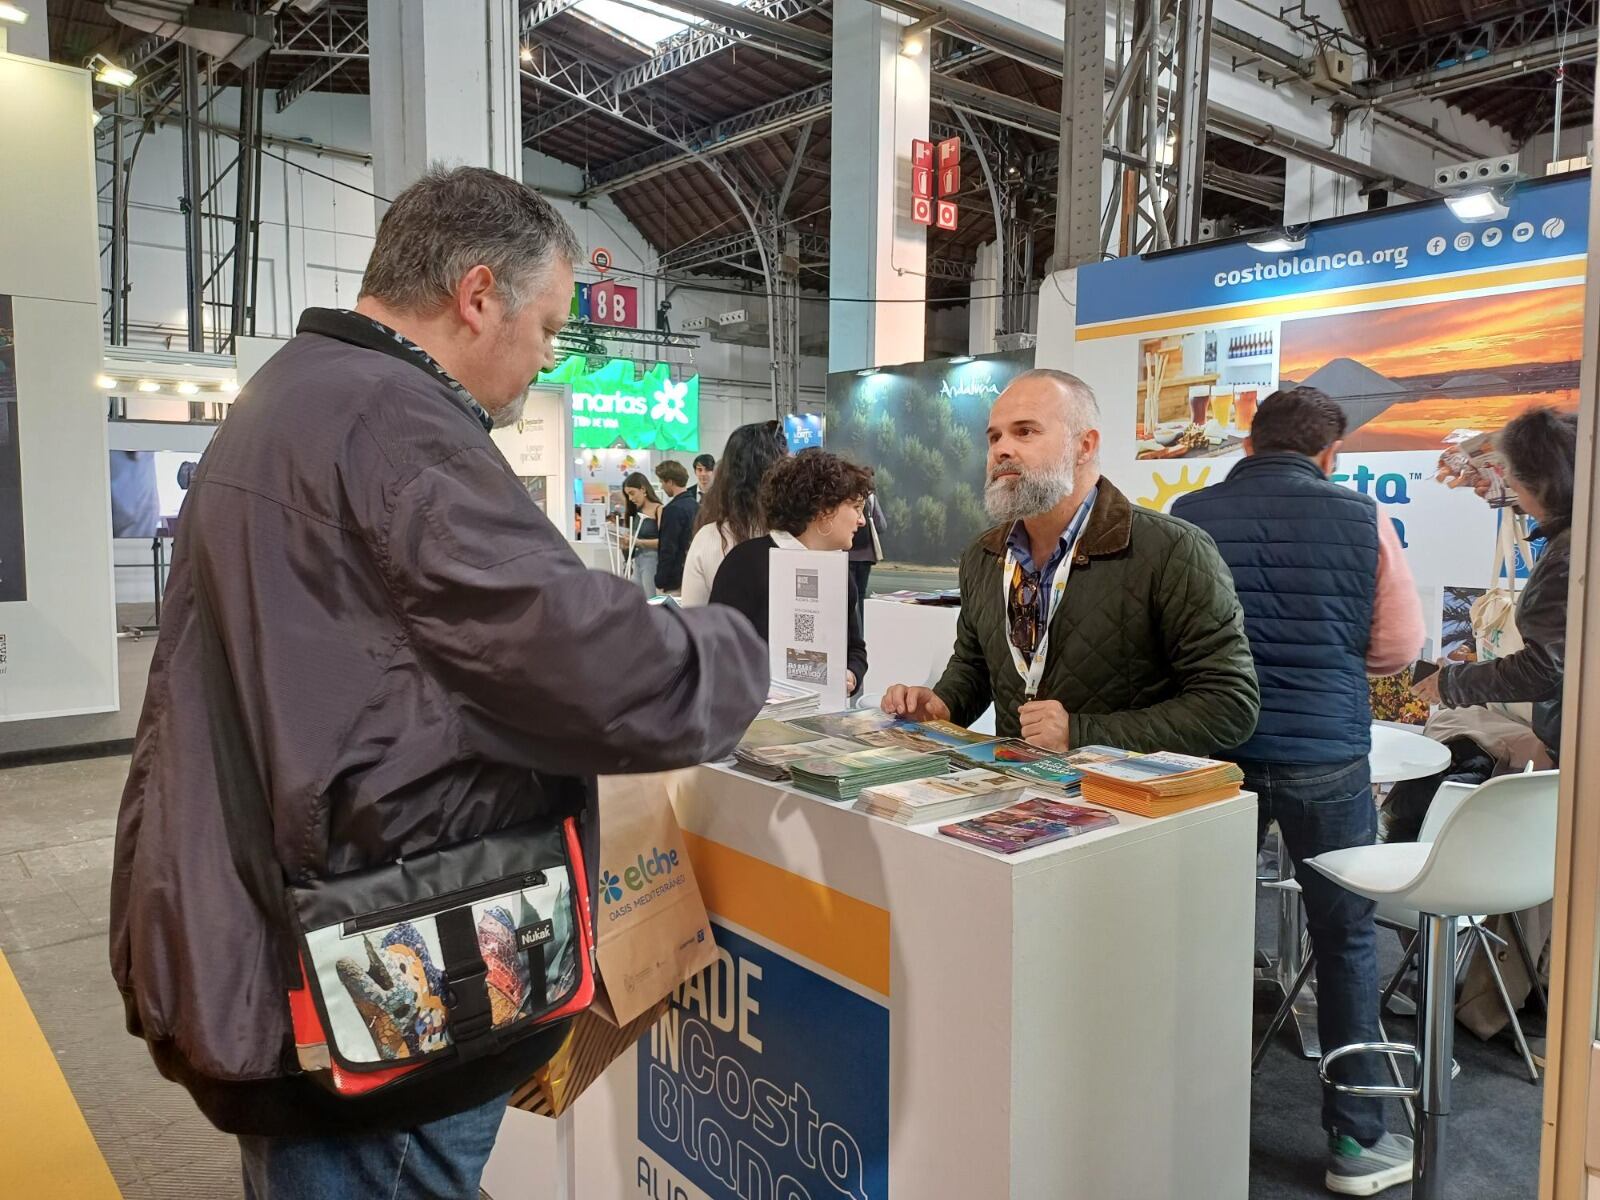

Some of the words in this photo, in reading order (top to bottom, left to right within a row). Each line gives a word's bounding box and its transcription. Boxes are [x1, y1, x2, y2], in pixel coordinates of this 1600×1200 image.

[1214, 246, 1409, 287] costablanca.org
[624, 847, 679, 891] elche
[609, 903, 633, 922] OASIS
[673, 945, 763, 1054] ADE
[651, 1007, 679, 1074] IN
[681, 1018, 868, 1200] Costa
